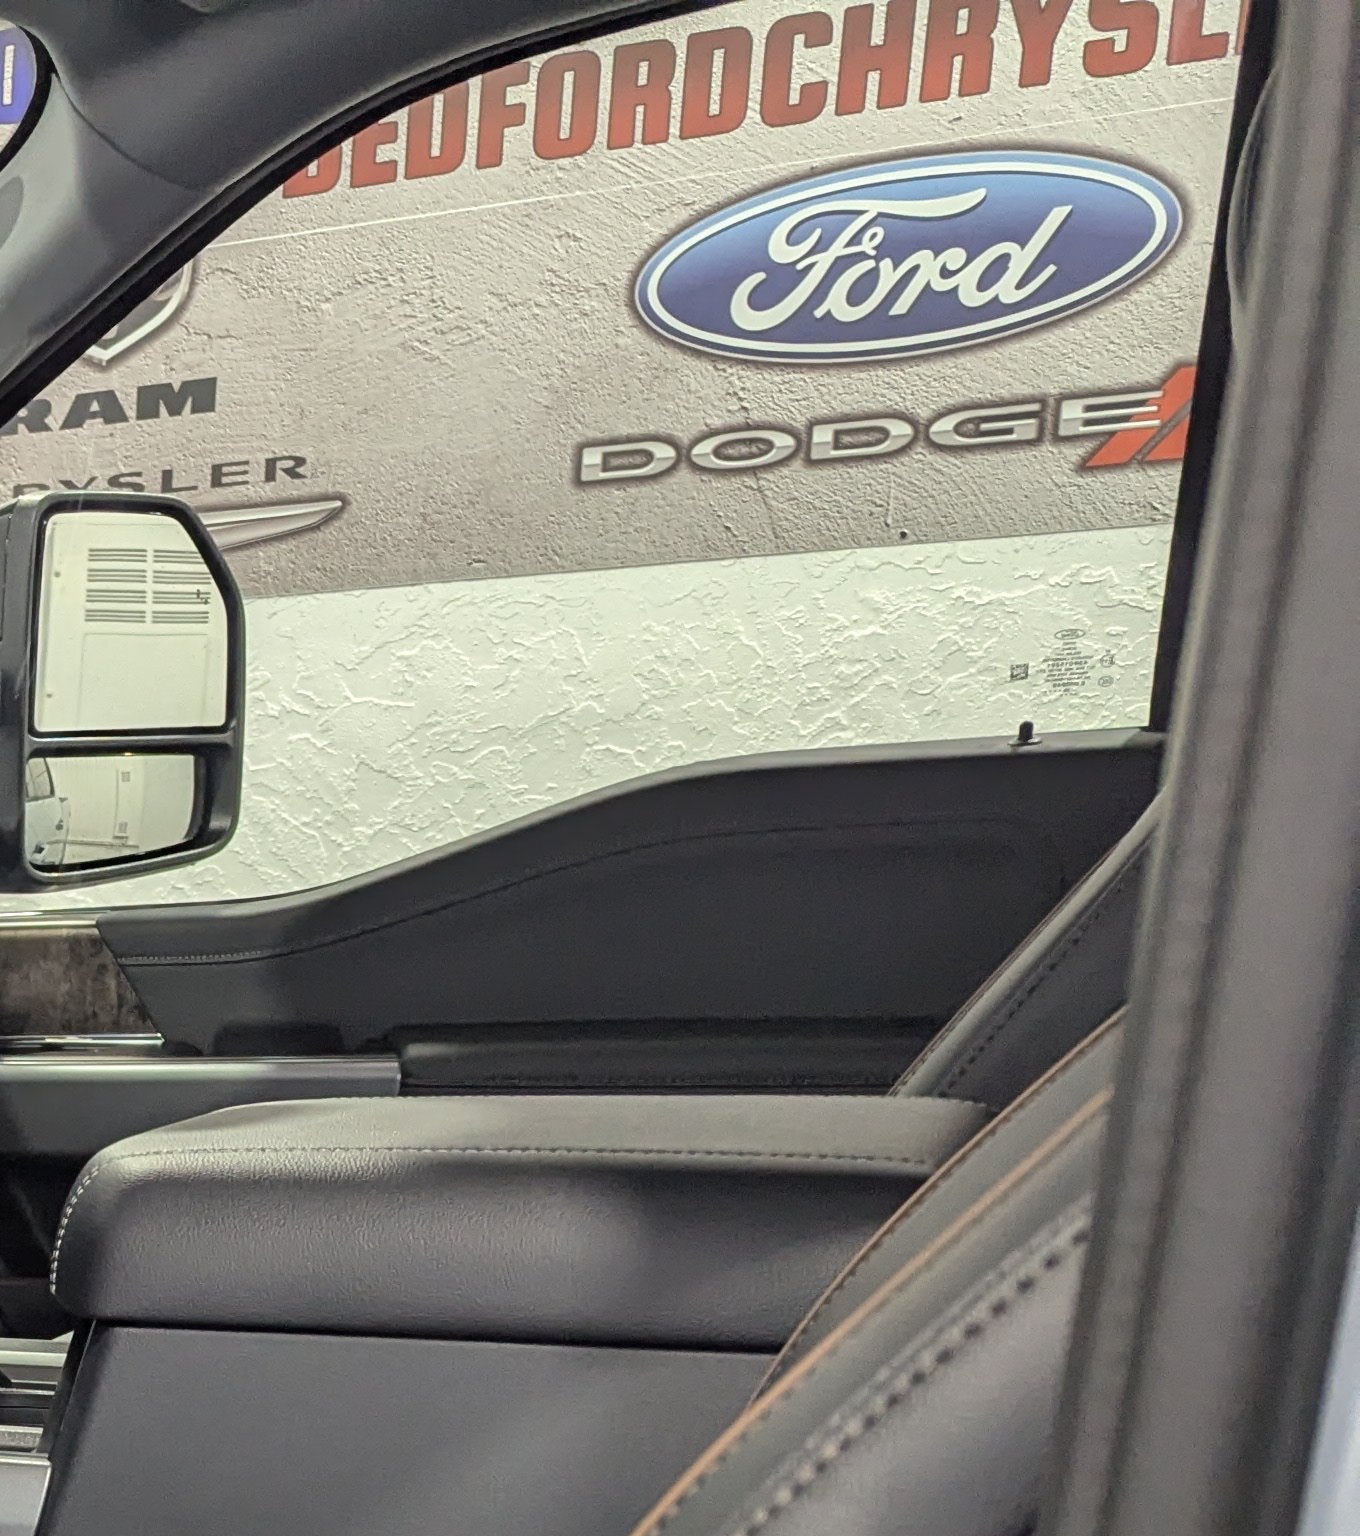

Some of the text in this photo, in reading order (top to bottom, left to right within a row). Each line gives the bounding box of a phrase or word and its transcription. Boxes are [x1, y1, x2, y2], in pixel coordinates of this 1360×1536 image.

[282, 0, 1245, 198] EDFORDCHRYSL
[730, 187, 1074, 332] Ford
[580, 390, 1166, 483] DODGE
